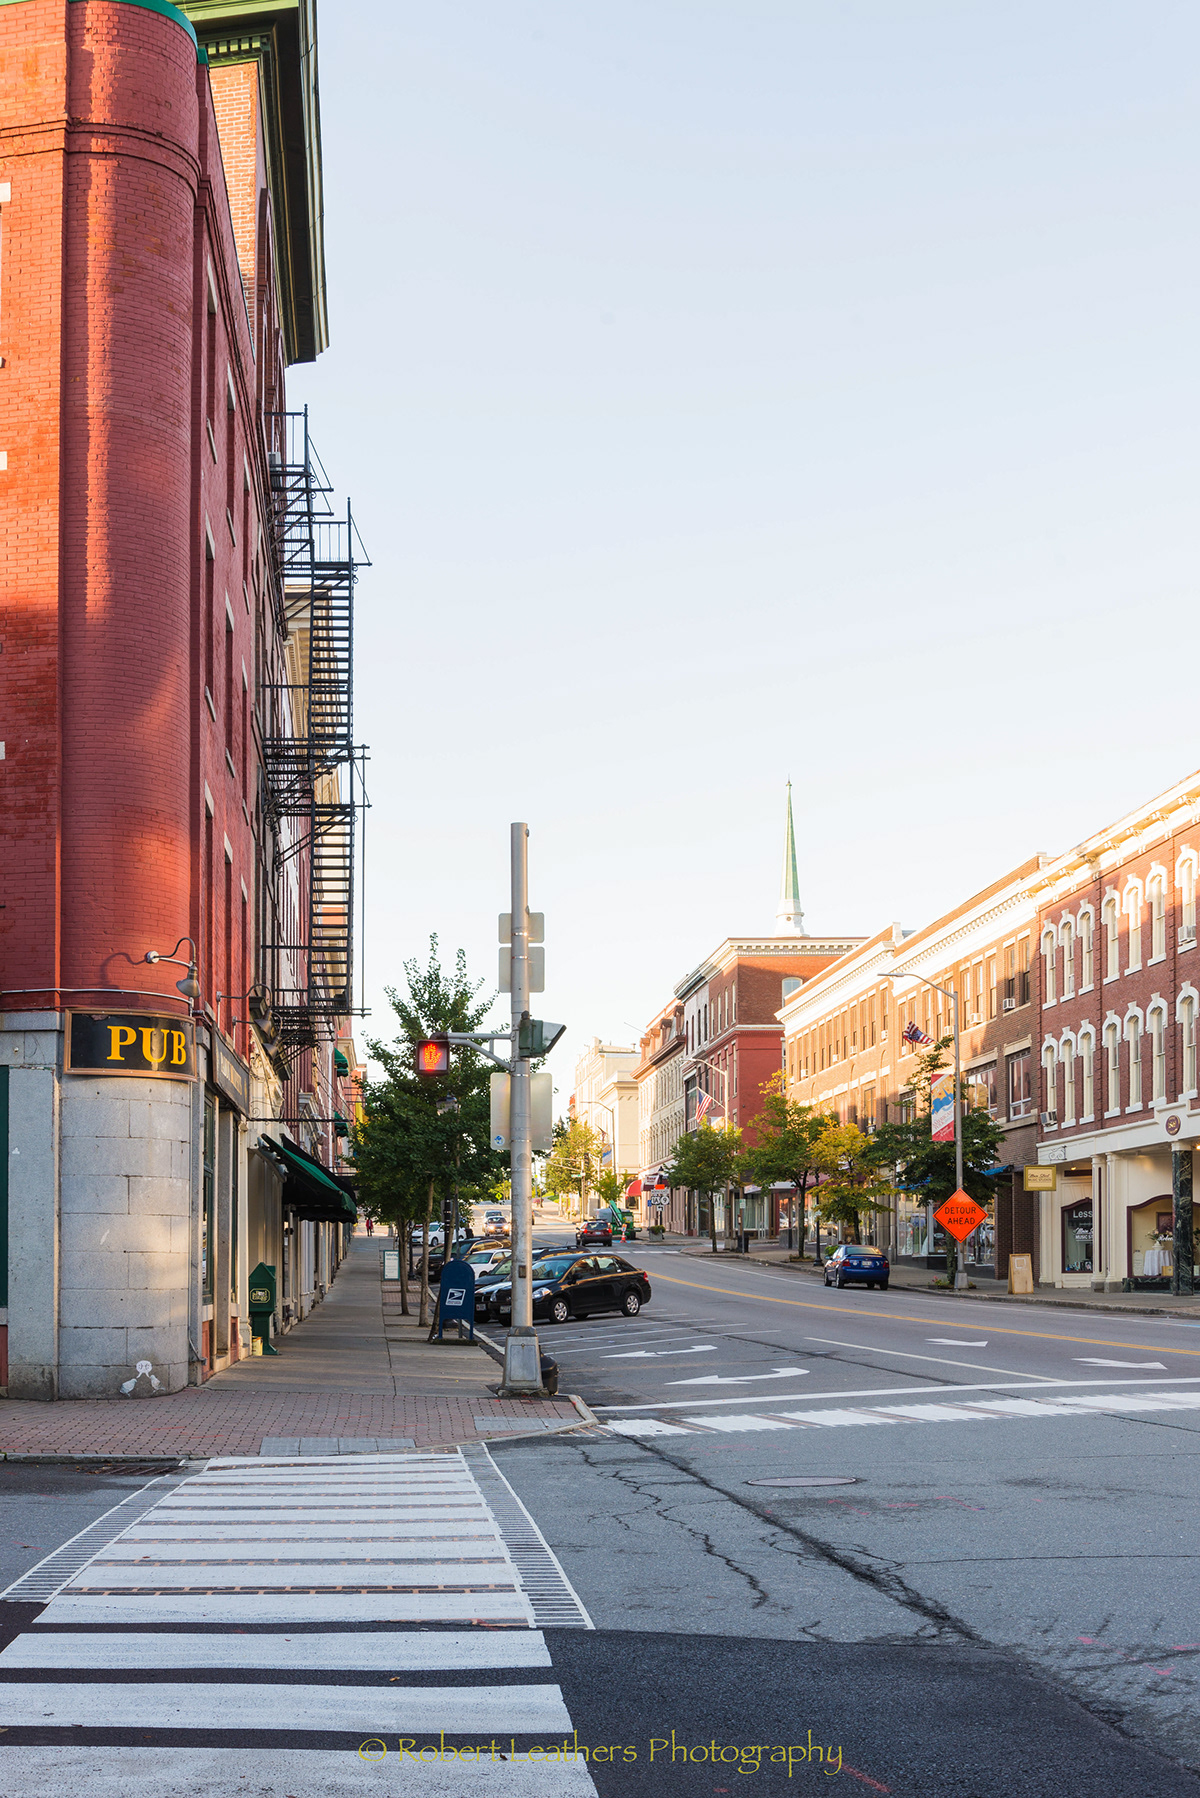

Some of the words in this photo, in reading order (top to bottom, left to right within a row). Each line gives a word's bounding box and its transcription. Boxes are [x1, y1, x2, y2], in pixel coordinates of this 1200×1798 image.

[106, 1025, 187, 1065] PUB
[944, 1206, 977, 1215] DETOUR
[947, 1216, 976, 1225] AHEAD
